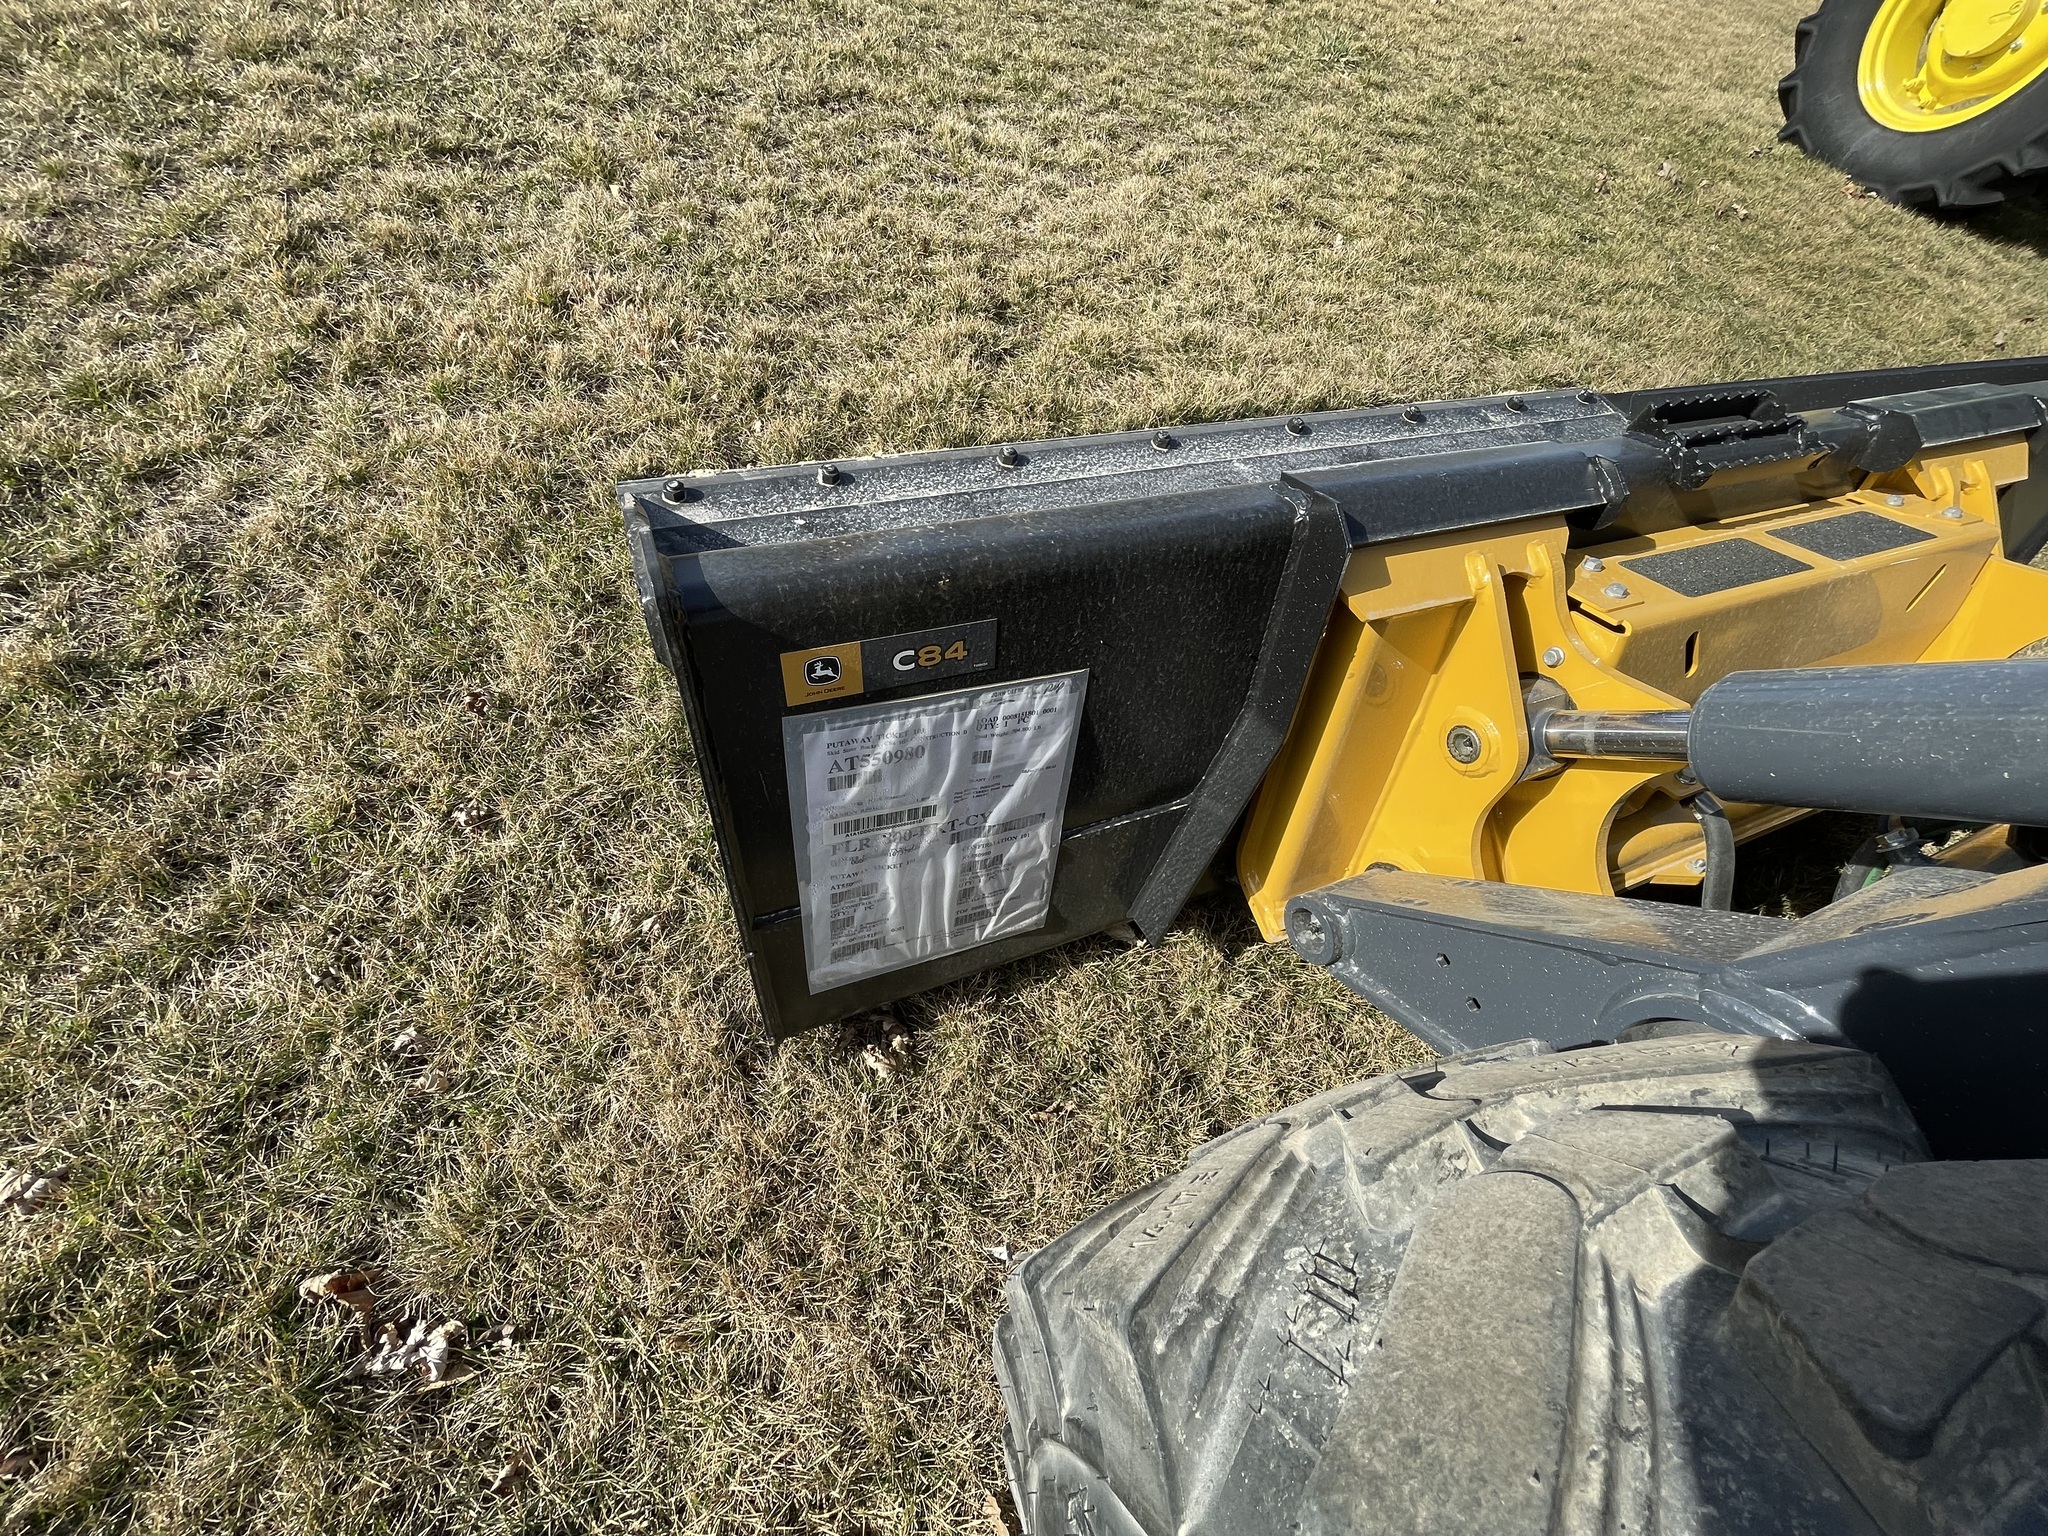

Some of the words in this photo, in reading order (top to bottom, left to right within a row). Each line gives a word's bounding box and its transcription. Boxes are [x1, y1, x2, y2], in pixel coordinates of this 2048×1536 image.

[892, 640, 968, 671] C84
[805, 690, 823, 698] JOHN
[824, 686, 846, 695] DEERE
[826, 735, 873, 749] PUTAWAY
[828, 745, 925, 774] AT550980
